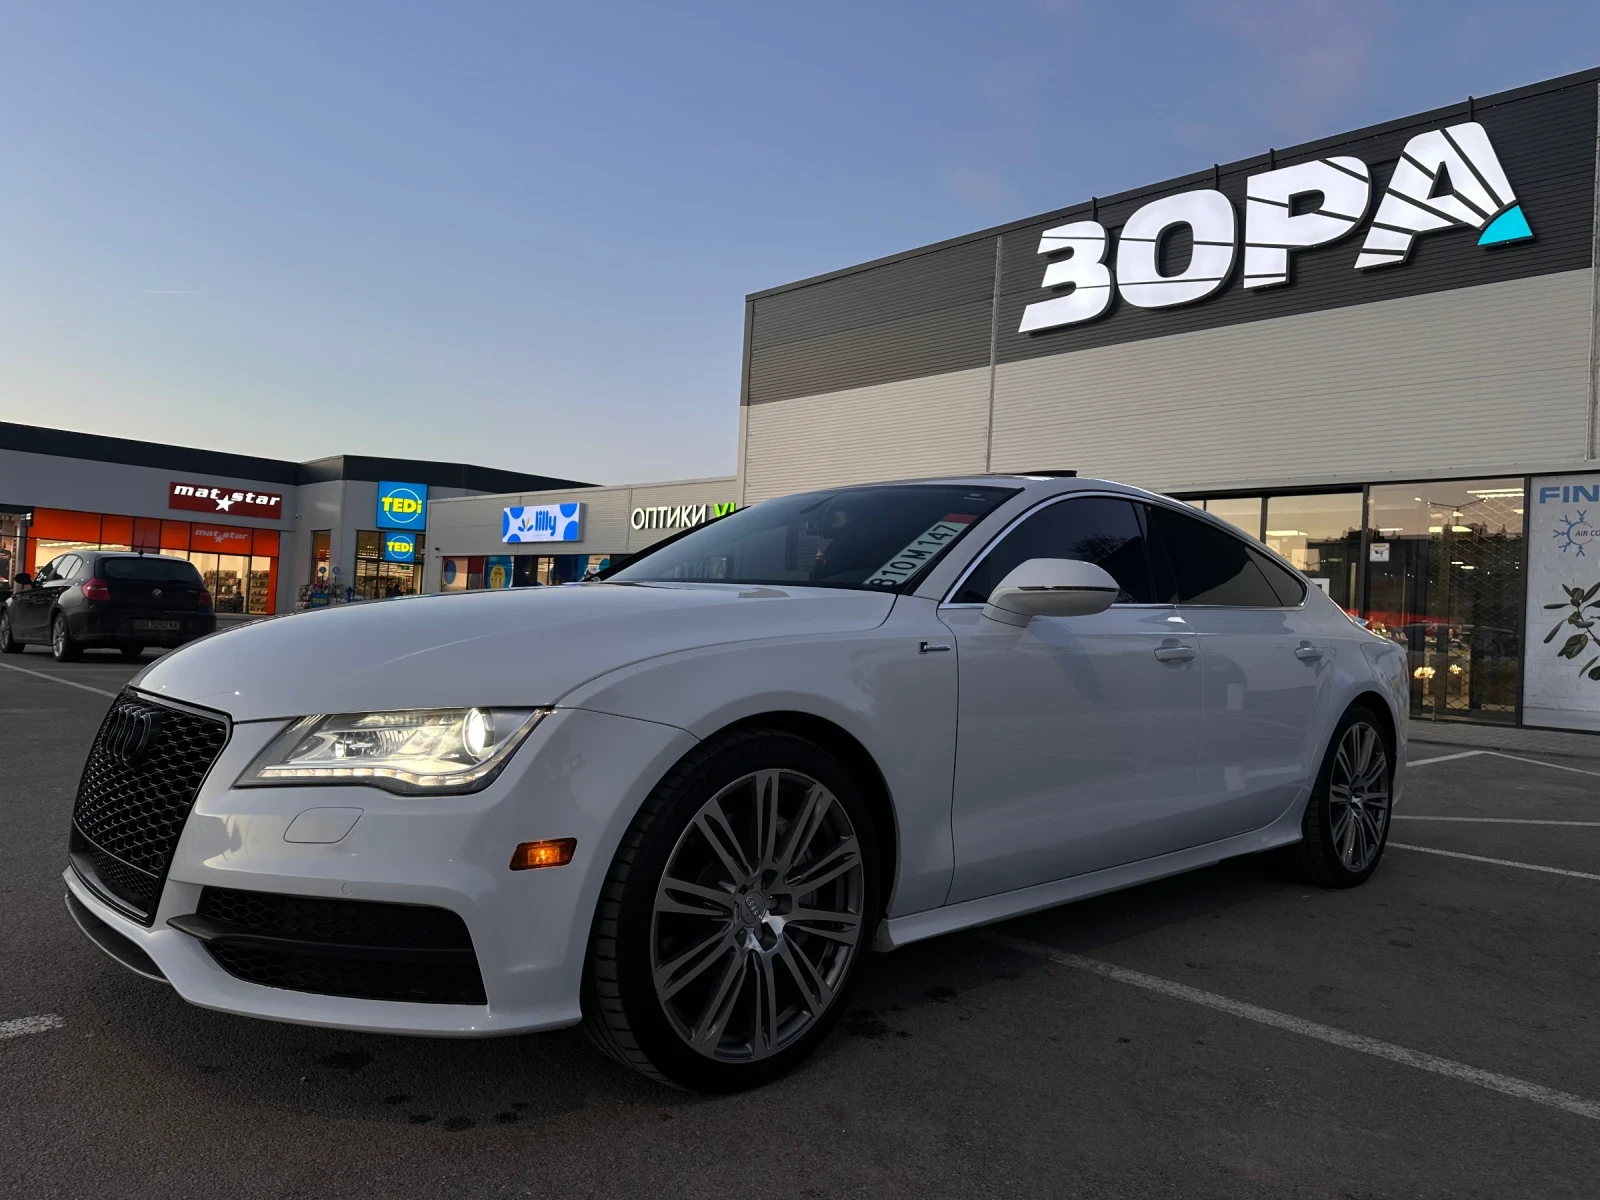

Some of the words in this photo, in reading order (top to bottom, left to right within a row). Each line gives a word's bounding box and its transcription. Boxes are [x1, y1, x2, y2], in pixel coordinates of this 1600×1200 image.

[1018, 121, 1534, 335] ЗОРА
[174, 485, 221, 499] mat
[231, 492, 280, 506] star
[1539, 485, 1599, 504] FIN
[381, 497, 422, 514] TEDi
[535, 510, 556, 537] lilly
[631, 504, 706, 529] ОПТИКИ
[195, 529, 219, 537] mat
[222, 531, 248, 539] star
[387, 541, 413, 553] TEDi
